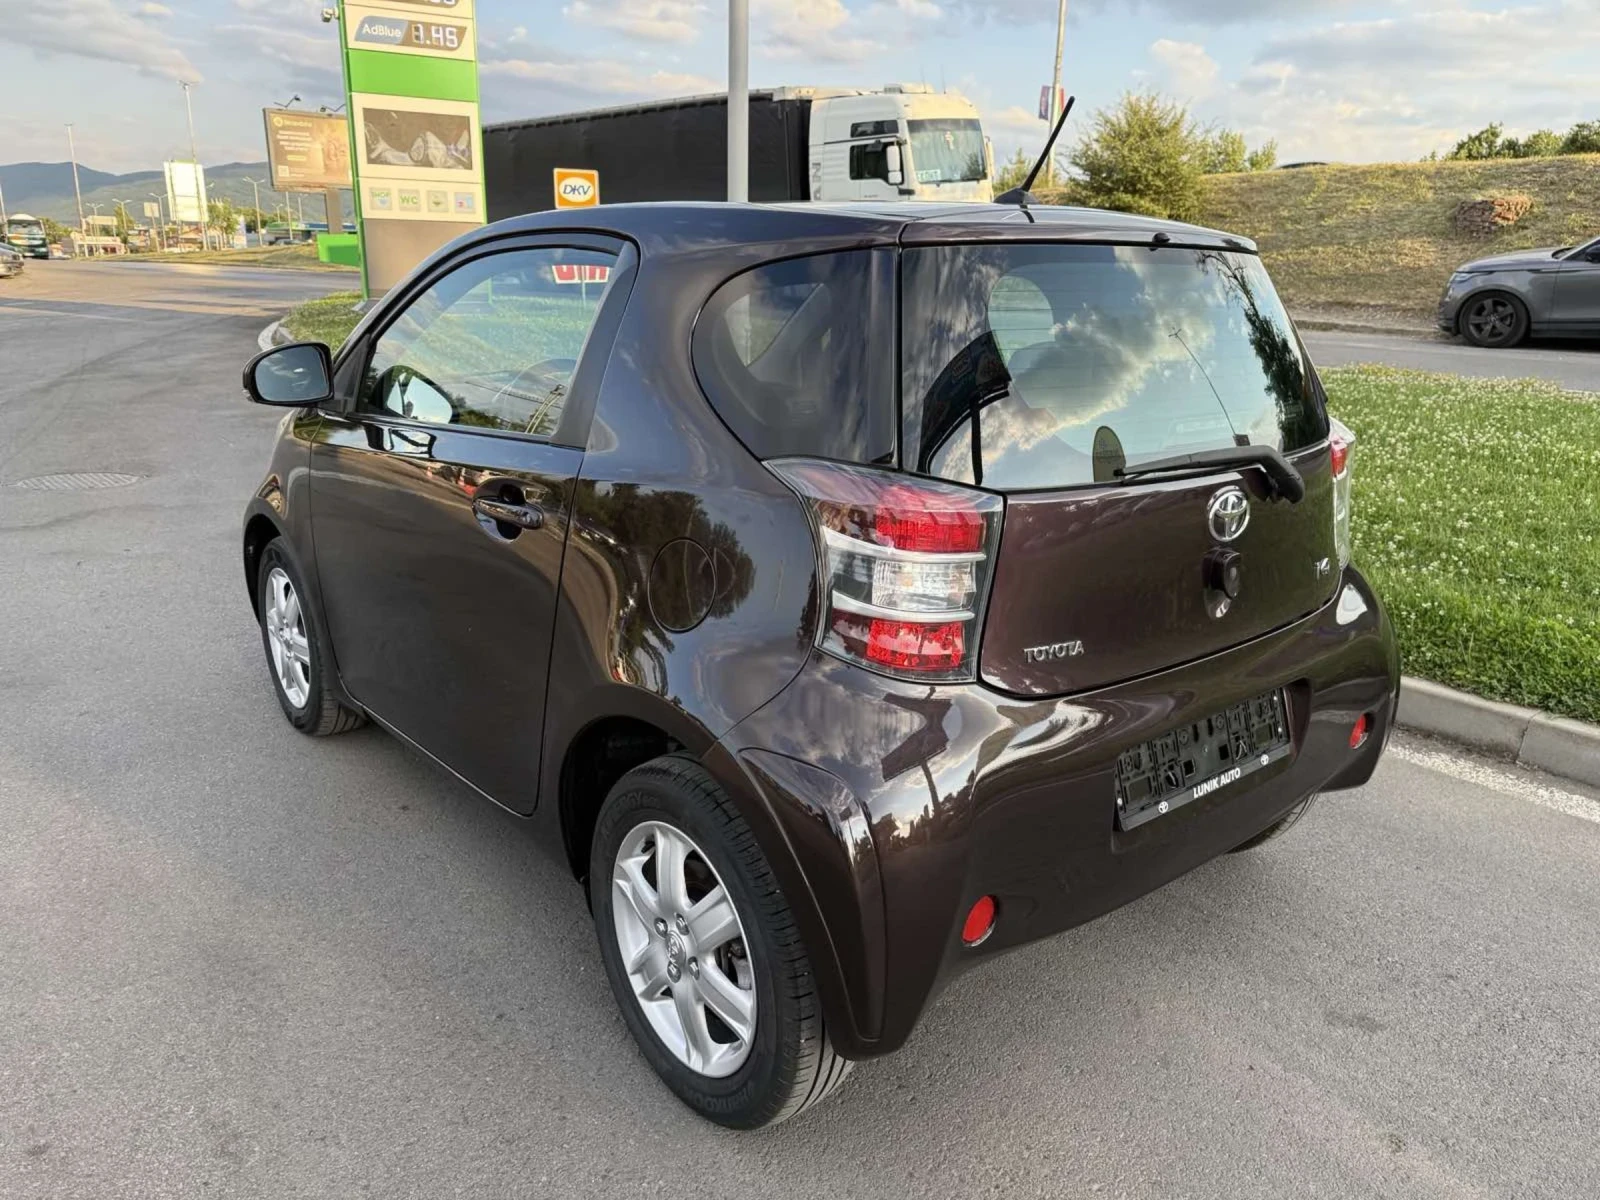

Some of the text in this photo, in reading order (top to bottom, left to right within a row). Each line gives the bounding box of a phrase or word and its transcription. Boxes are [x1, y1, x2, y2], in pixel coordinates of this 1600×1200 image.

[362, 23, 402, 37] AdBlue
[563, 184, 591, 196] DKV
[400, 194, 419, 205] WC
[1023, 640, 1085, 663] TOYOTA
[1193, 767, 1241, 799] LUNIK AUTO
